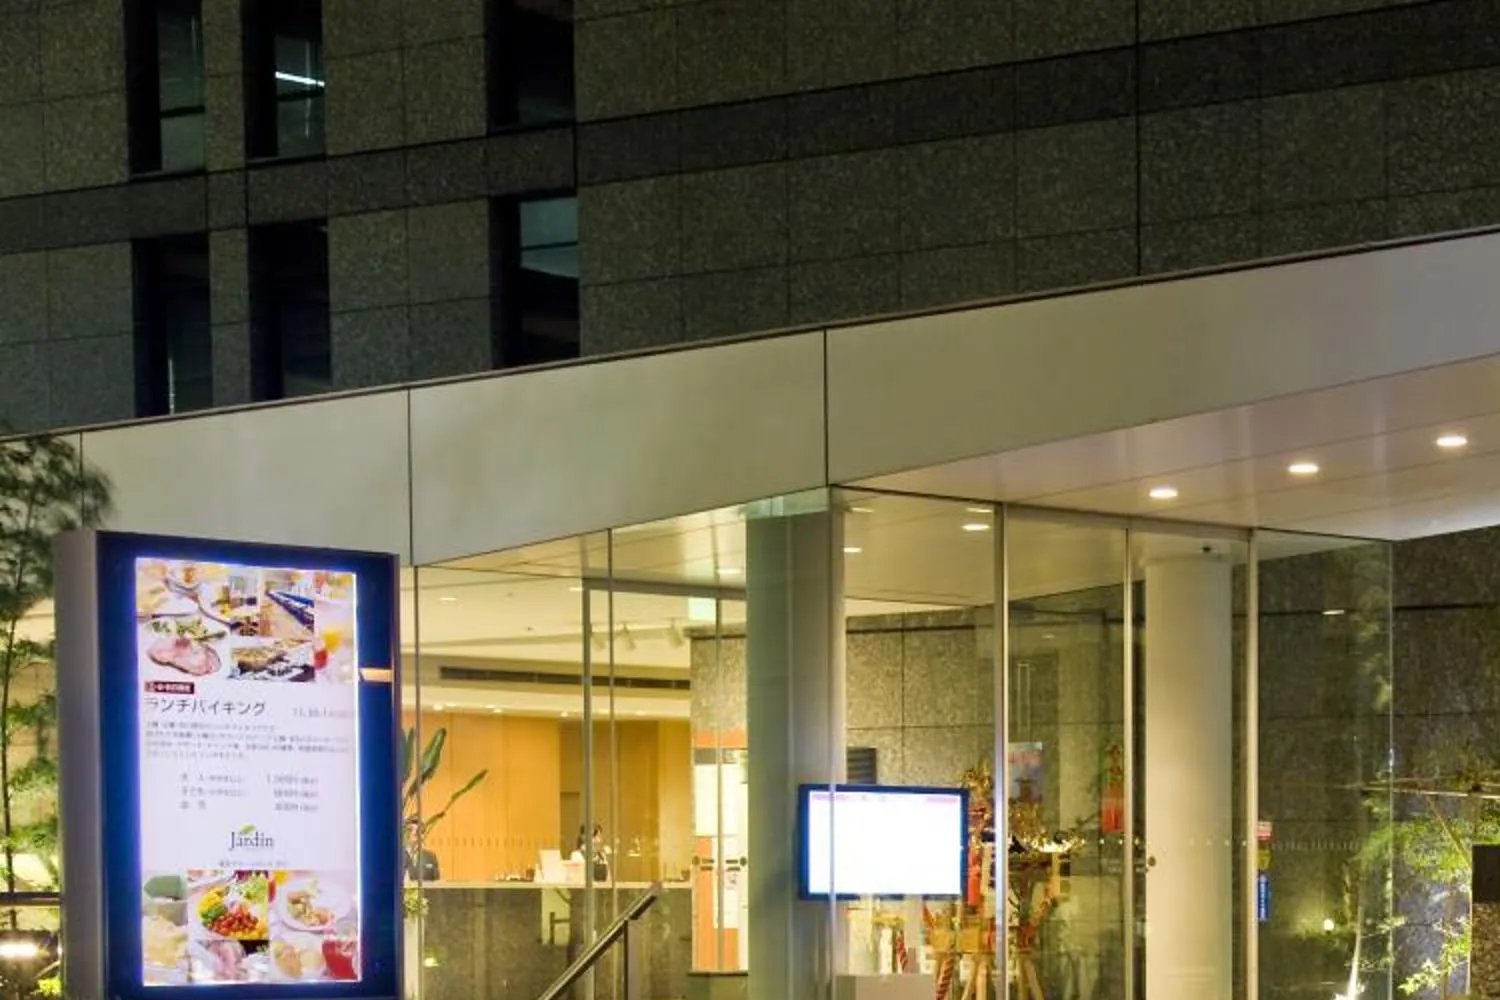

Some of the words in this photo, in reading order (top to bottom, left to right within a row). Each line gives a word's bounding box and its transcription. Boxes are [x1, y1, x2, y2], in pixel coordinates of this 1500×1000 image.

[144, 697, 266, 716] ランチバイキング
[229, 830, 274, 852] Jardin
